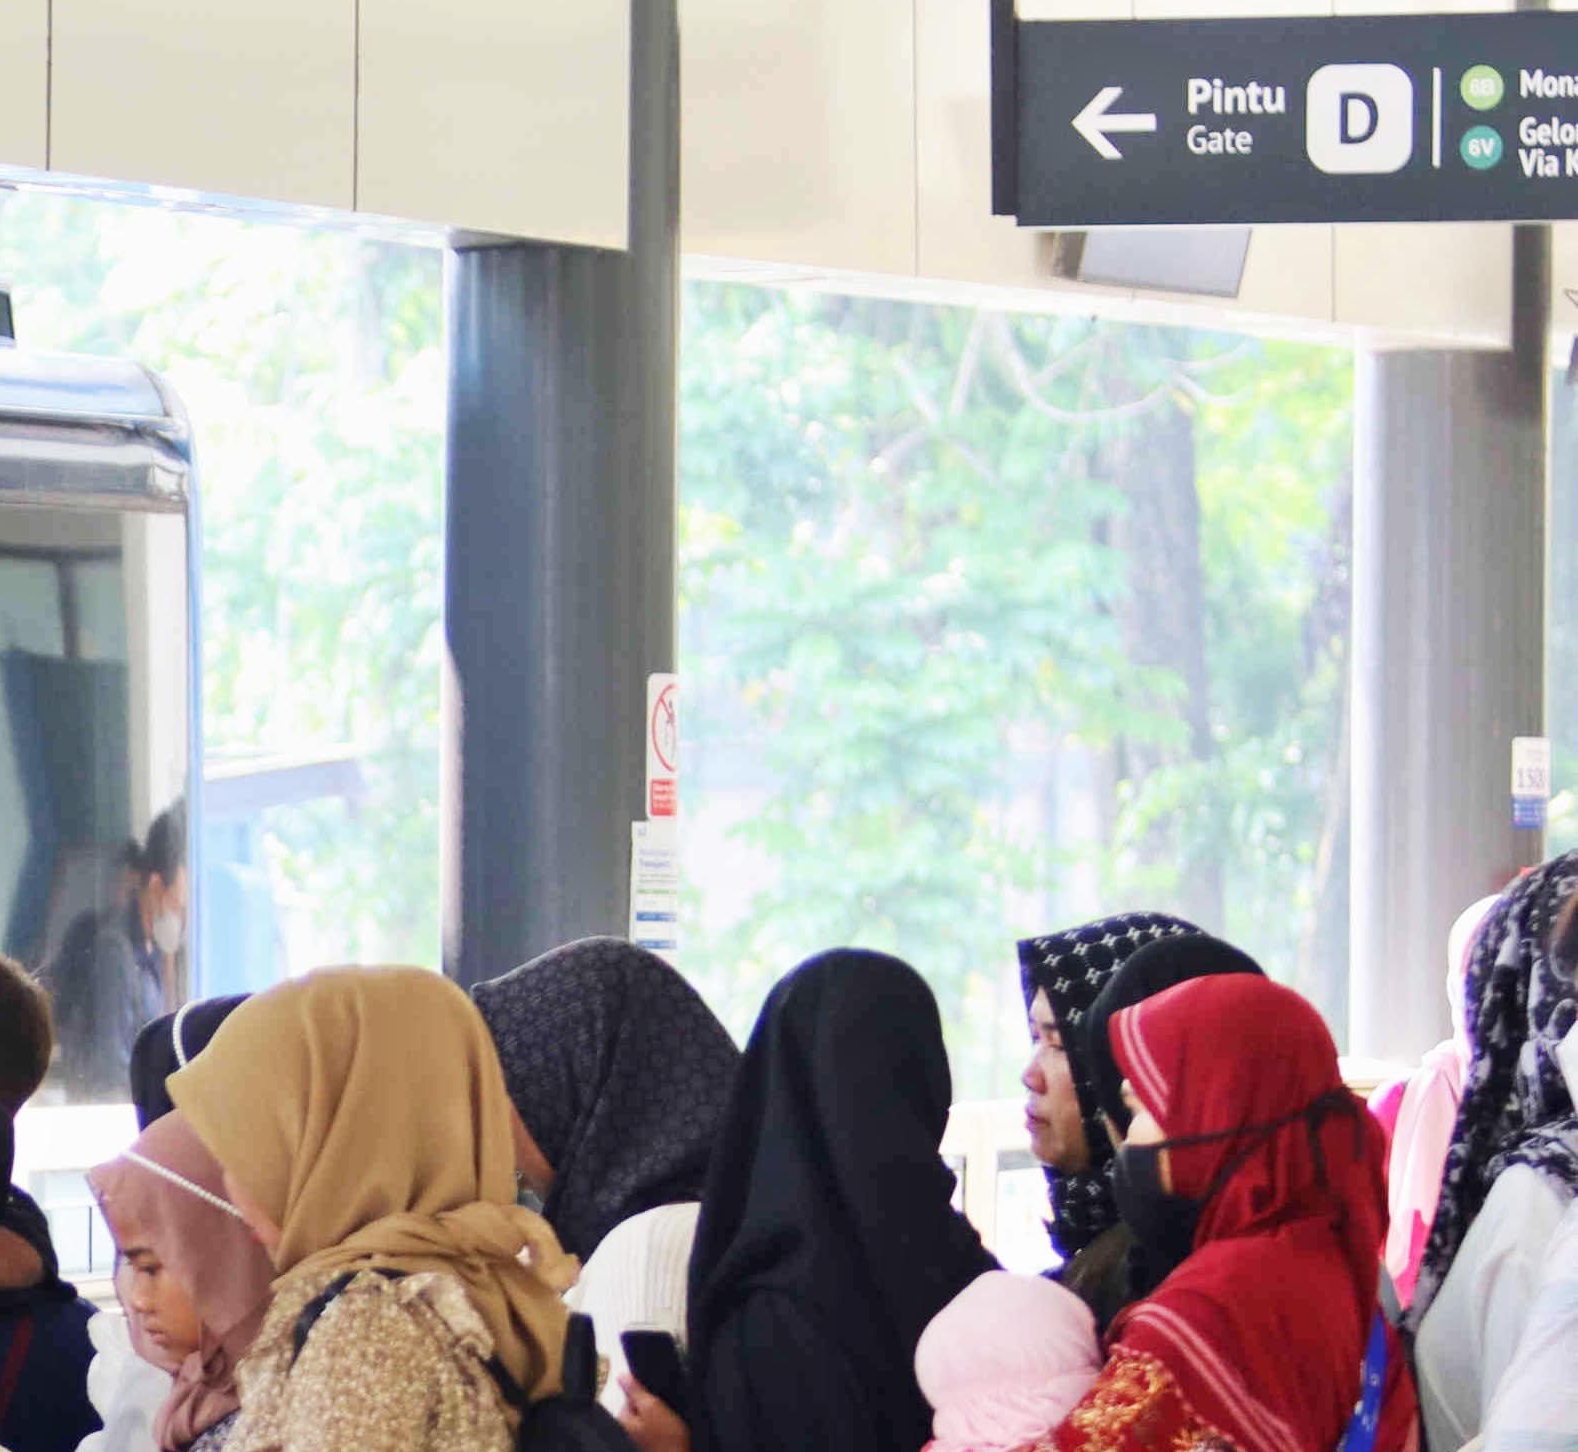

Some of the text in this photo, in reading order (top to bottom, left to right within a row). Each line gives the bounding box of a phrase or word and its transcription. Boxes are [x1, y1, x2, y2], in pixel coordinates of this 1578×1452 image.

[1187, 77, 1379, 144] Pintu D
[1186, 124, 1253, 155] Gate
[1519, 116, 1578, 147] Gelo
[1468, 138, 1495, 158] 6V
[1518, 148, 1560, 178] Via
